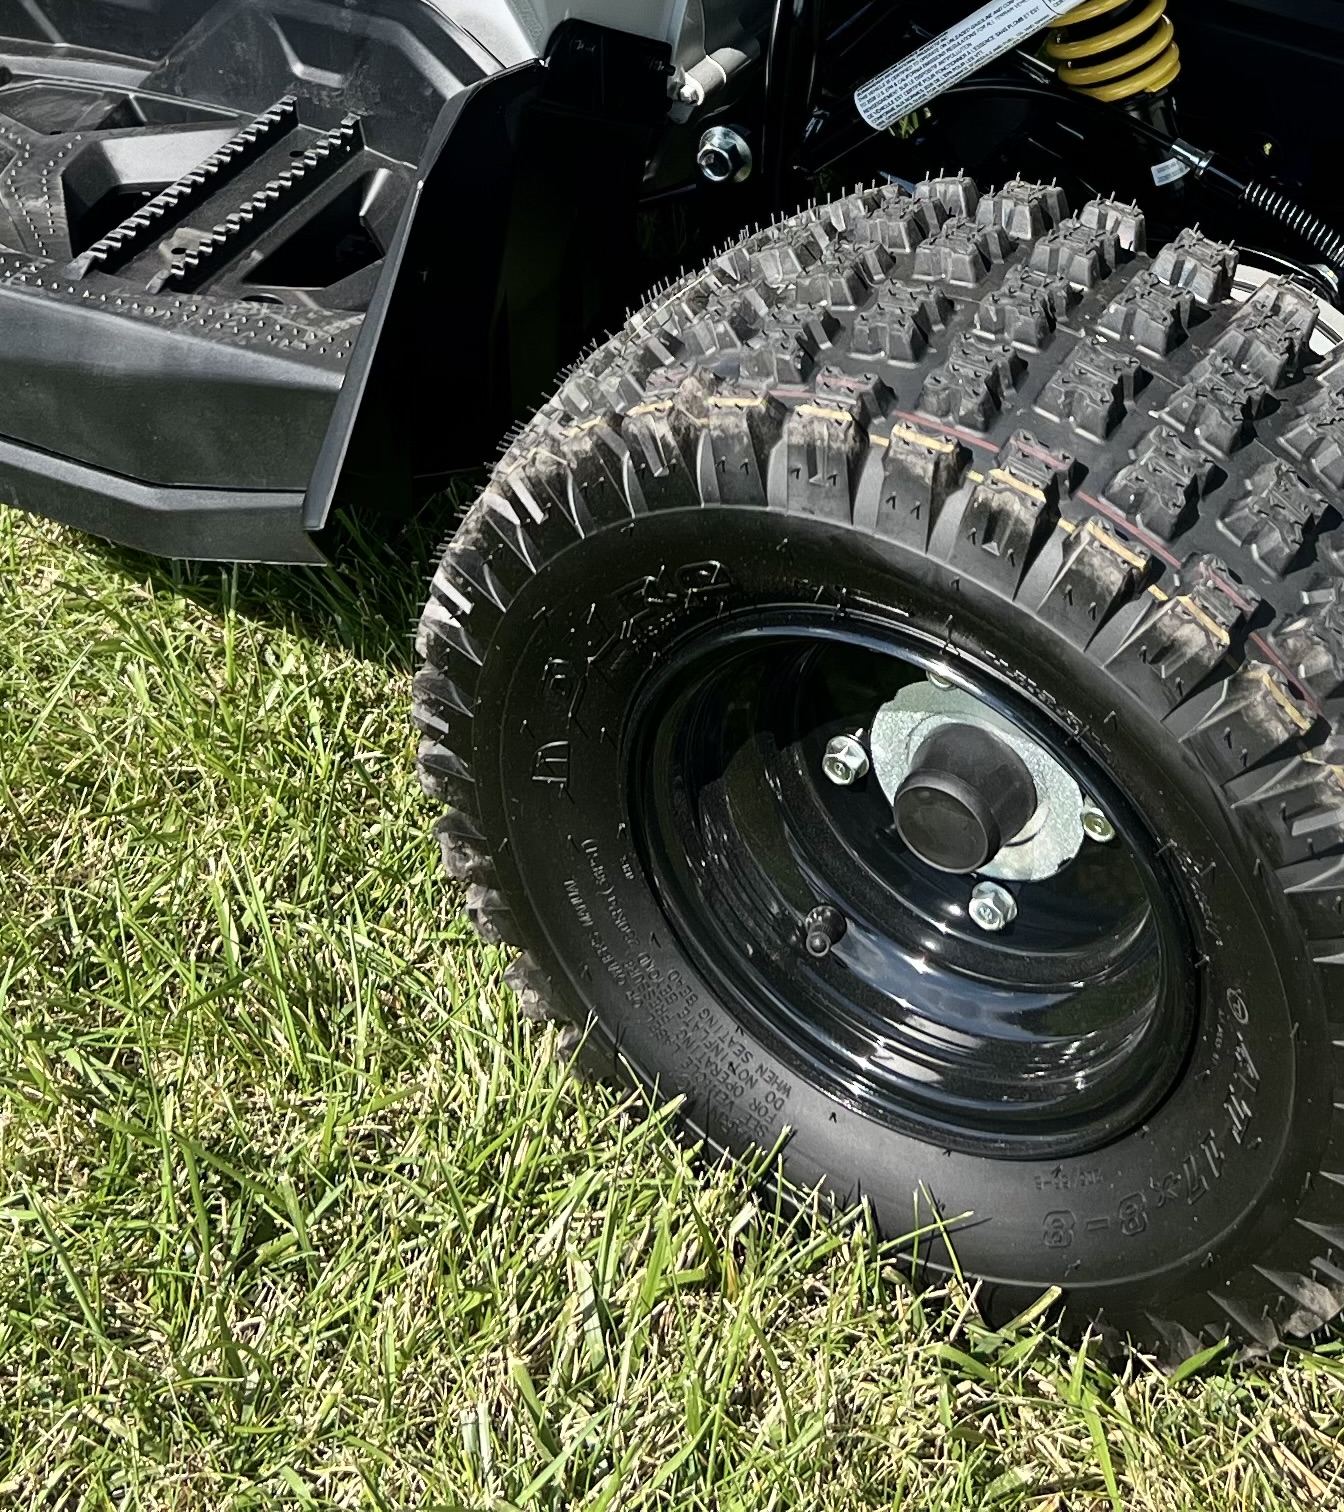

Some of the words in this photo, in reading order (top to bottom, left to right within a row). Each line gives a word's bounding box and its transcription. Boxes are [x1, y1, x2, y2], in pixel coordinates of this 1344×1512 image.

[616, 958, 678, 1024] PRESSURE
[674, 1006, 732, 1063] INFLATE
[695, 1006, 755, 1065] SEATING
[672, 1027, 747, 1099] OPERATING
[679, 1055, 738, 1111] VEHICLE
[753, 1060, 794, 1100] WHEN
[738, 1108, 770, 1140] SEE
[747, 1096, 778, 1127] FOR
[762, 1087, 786, 1113] DO
